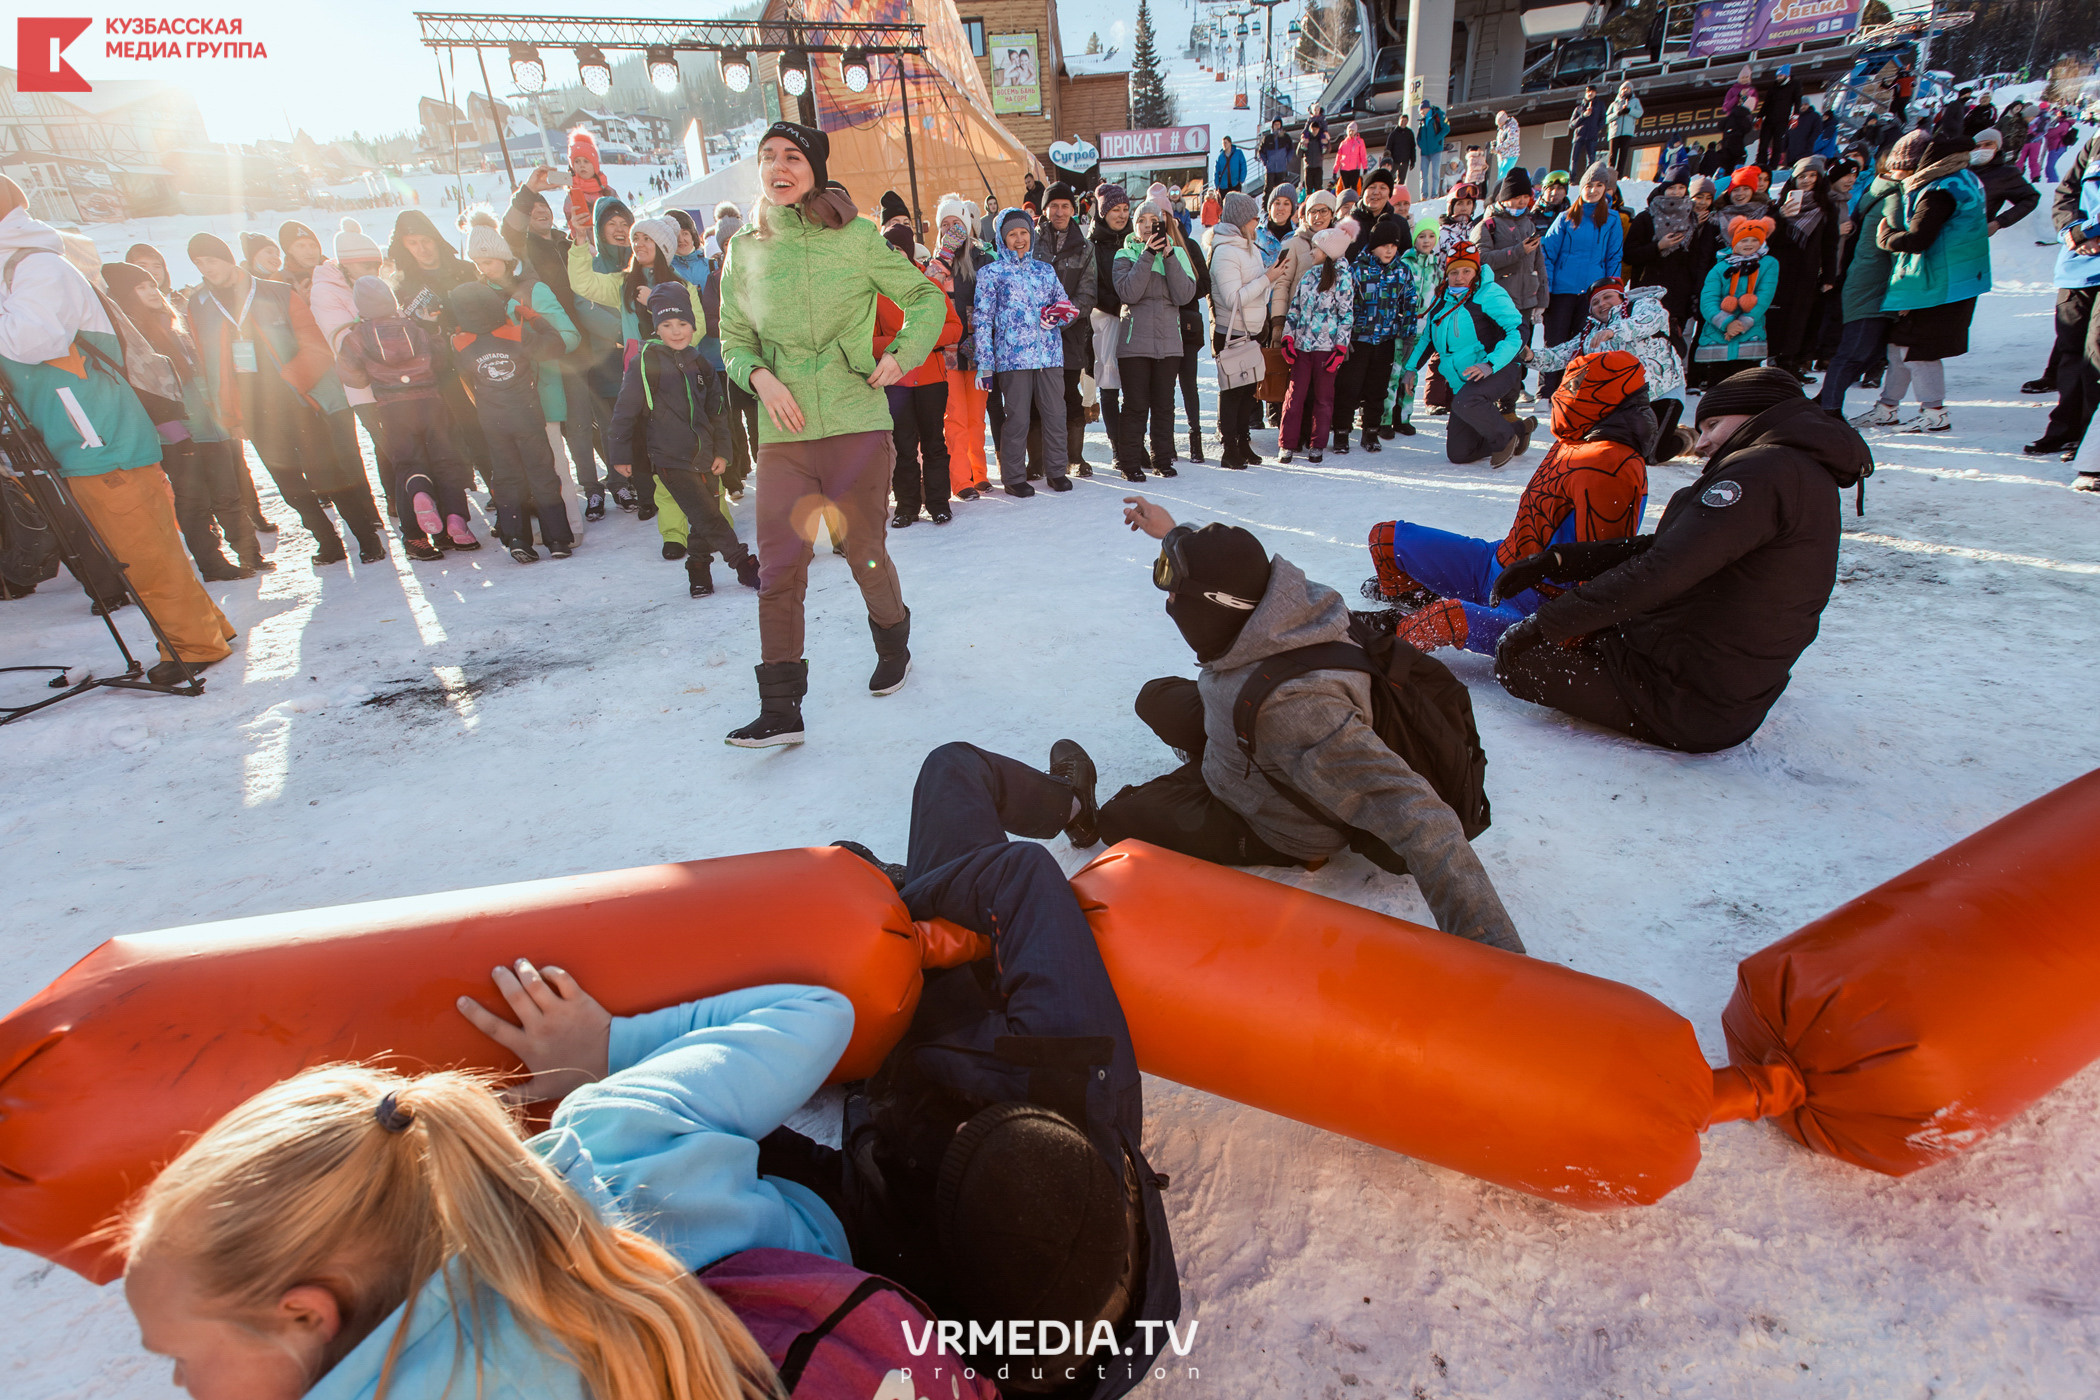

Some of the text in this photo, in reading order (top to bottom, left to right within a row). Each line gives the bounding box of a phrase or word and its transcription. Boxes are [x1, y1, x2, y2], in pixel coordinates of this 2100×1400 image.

[1789, 0, 1846, 18] BELKA
[1768, 26, 1815, 39] БЕСПЛАТНО
[1103, 130, 1200, 158] ПРОКАТ # 1
[1052, 147, 1096, 164] Сугроб
[476, 353, 509, 363] ТАШТАГОЛ
